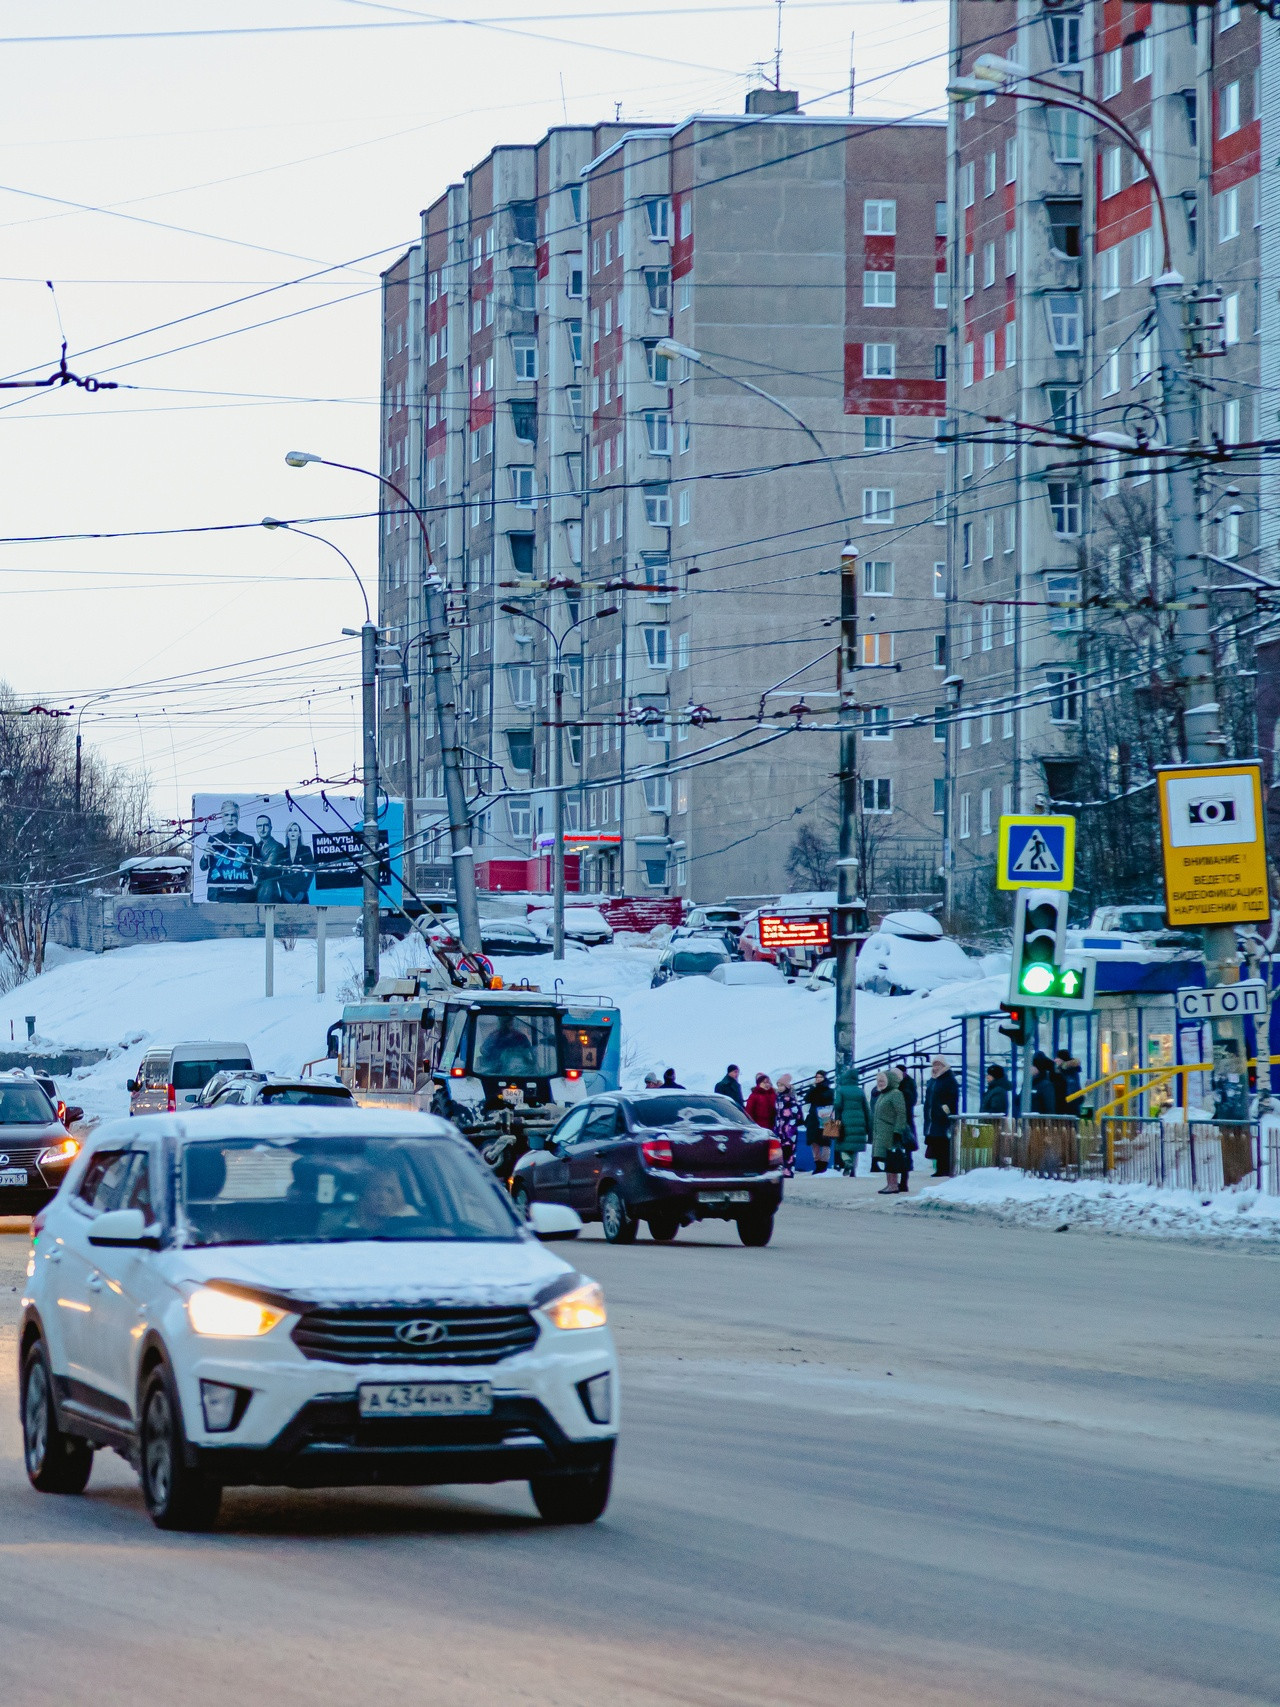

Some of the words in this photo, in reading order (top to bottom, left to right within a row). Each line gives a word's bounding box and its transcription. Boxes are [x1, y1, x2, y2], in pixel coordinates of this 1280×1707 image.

[1183, 854, 1240, 867] ВНИМАНИЕ
[222, 868, 249, 880] Wink
[1193, 873, 1241, 886] ВЕДЕТСЯ
[1172, 886, 1265, 901] ВИДЕОФИКСАЦИЯ
[1183, 990, 1259, 1014] СТОП
